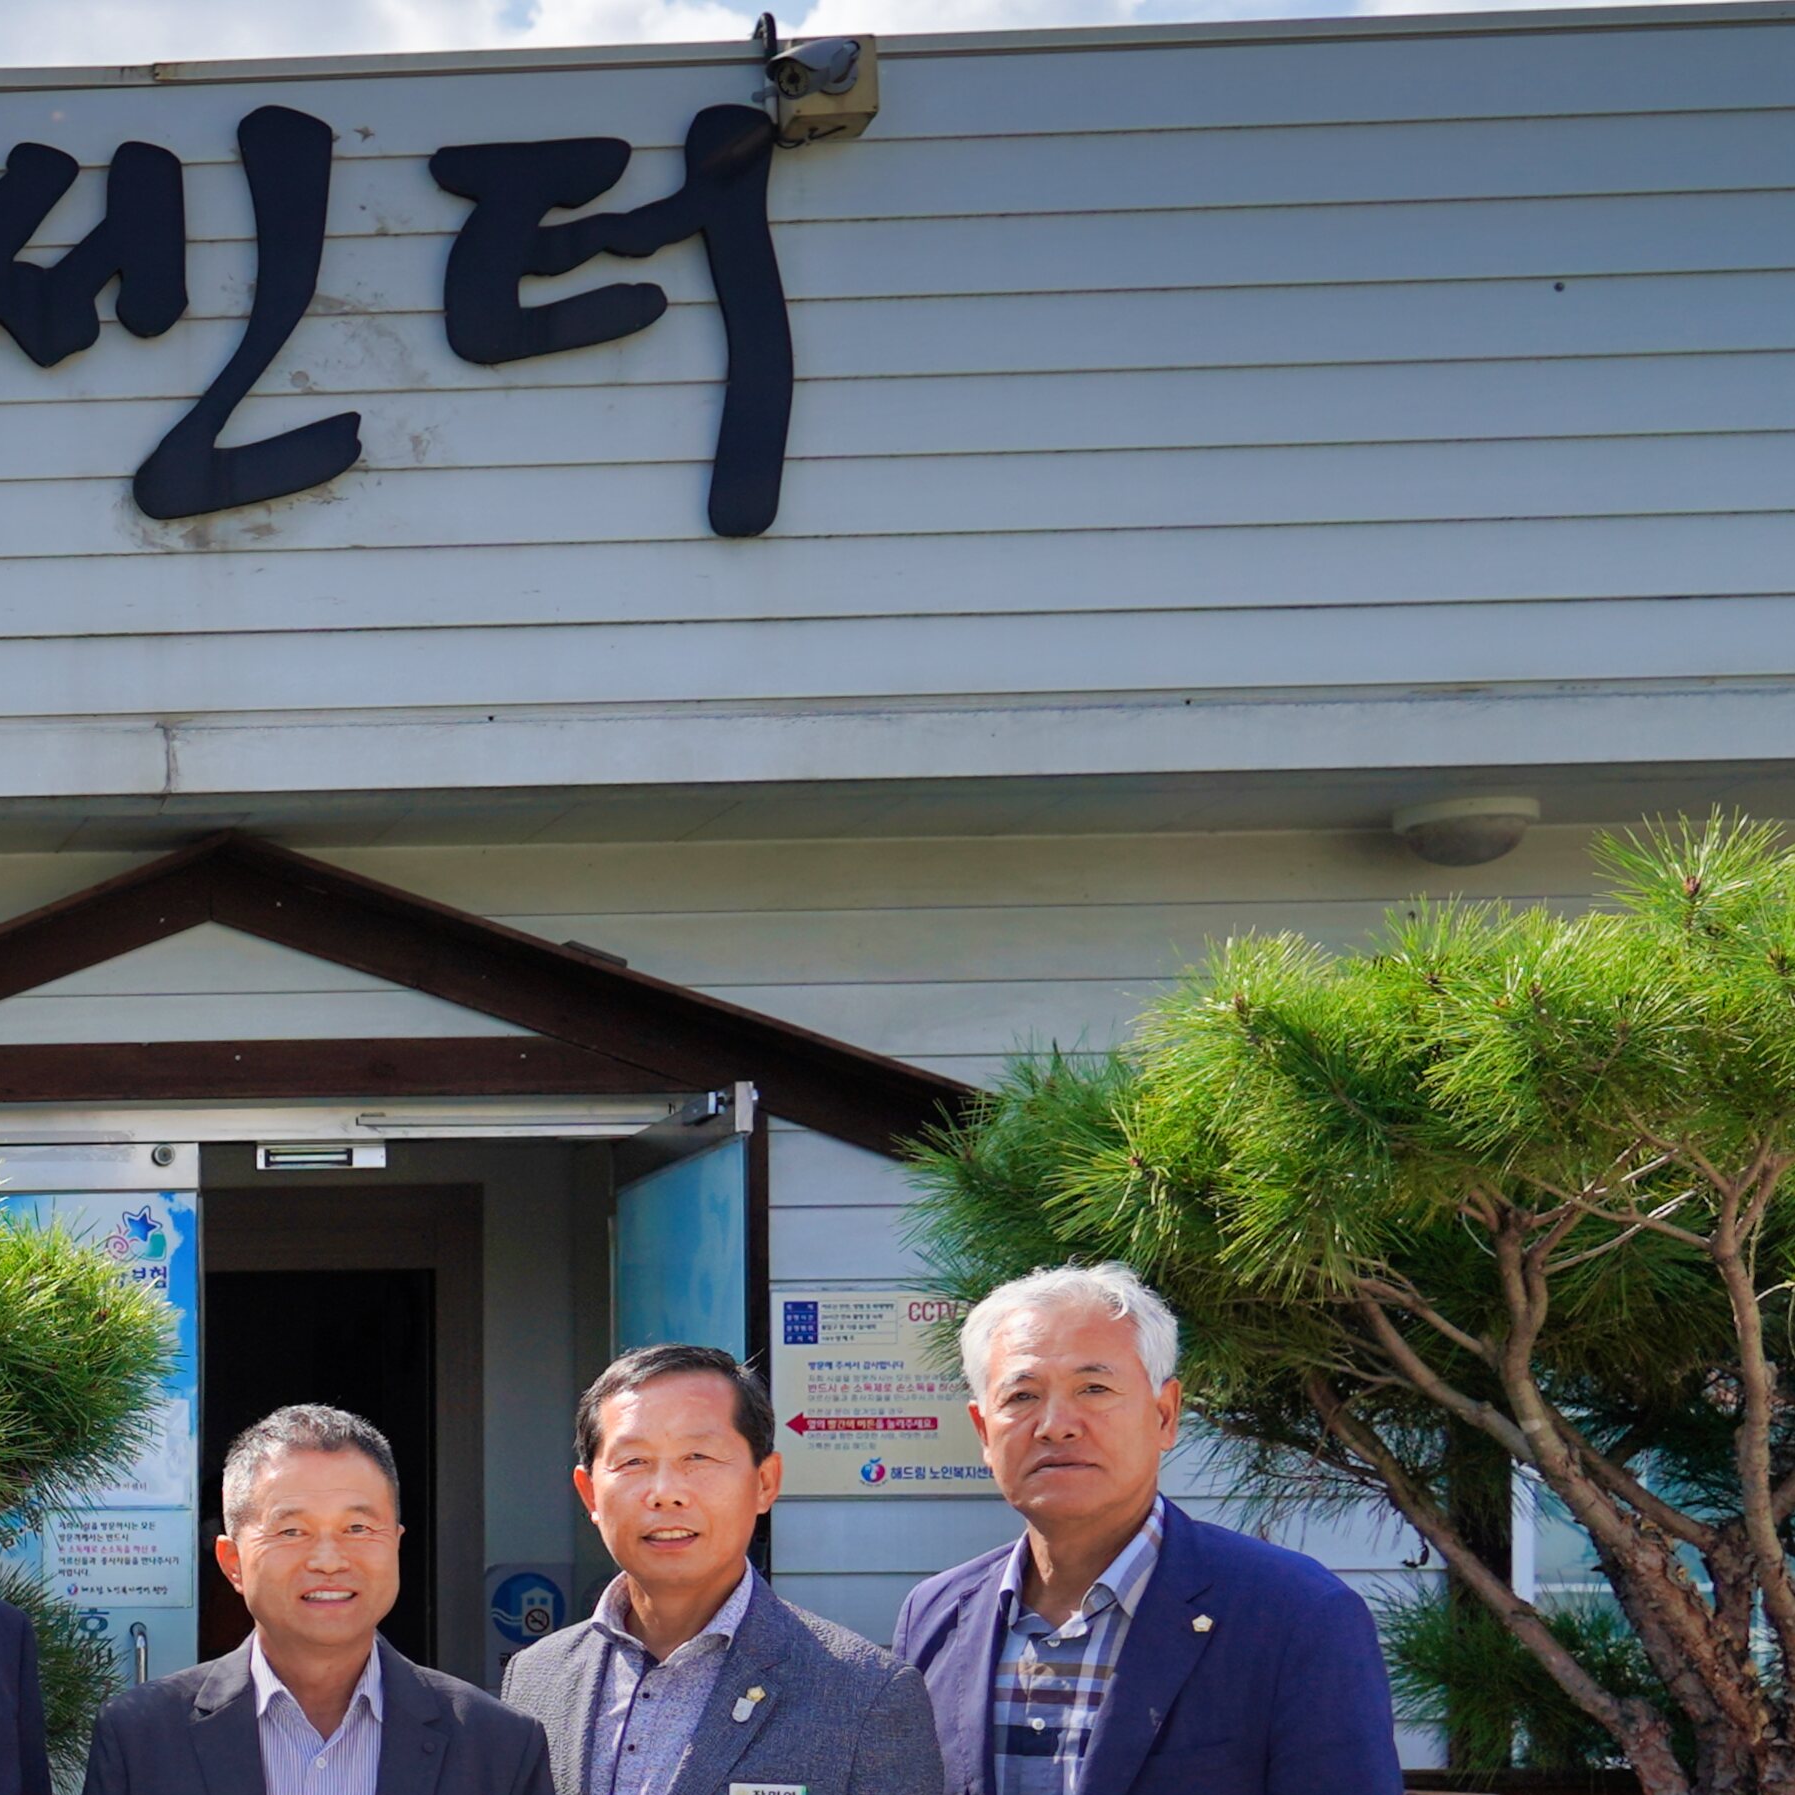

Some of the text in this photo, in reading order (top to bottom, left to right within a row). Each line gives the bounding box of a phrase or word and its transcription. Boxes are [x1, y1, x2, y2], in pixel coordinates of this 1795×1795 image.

[909, 1302, 957, 1322] CCTV
[808, 1383, 837, 1392] 반드시
[853, 1383, 891, 1392] 소독제로
[896, 1383, 935, 1392] 손소독을
[890, 1467, 926, 1480] 해드림
